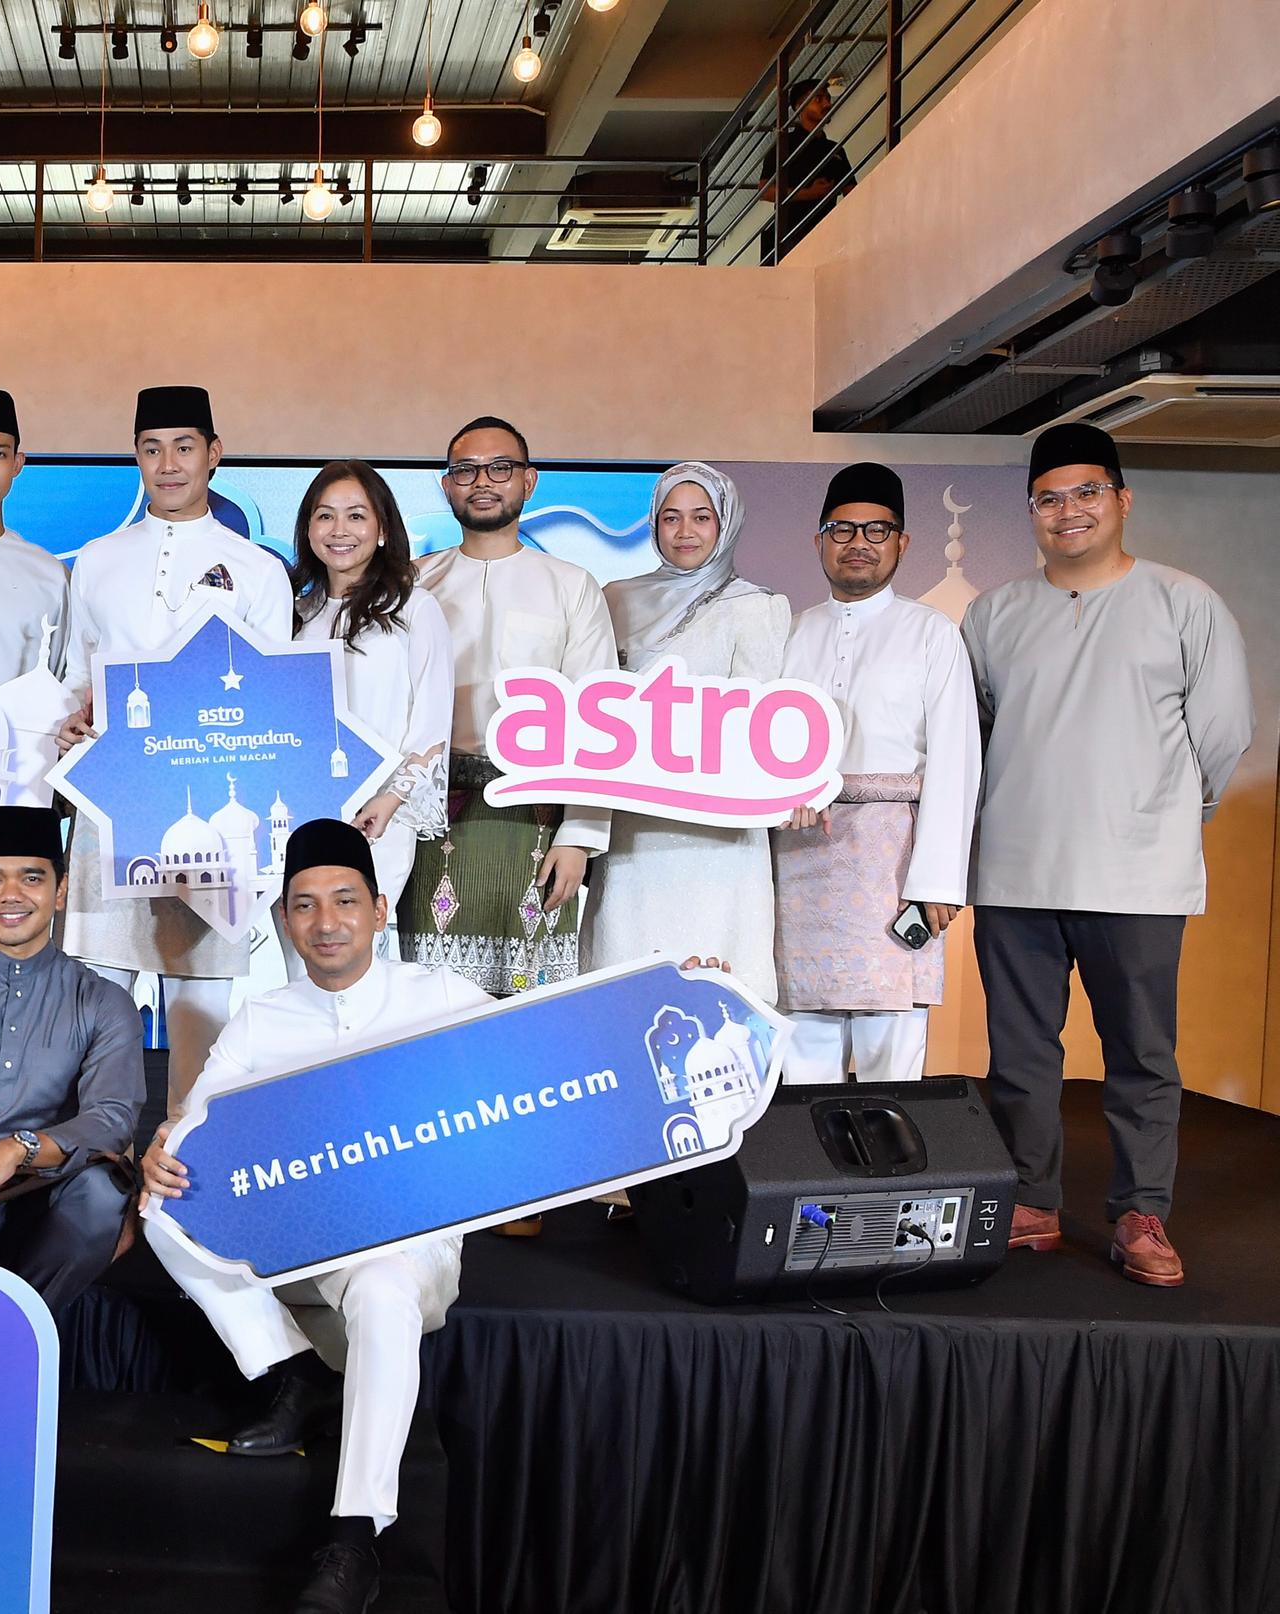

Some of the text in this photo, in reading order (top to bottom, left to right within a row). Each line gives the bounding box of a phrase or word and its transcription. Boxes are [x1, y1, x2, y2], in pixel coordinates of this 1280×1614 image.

[197, 706, 244, 723] astro
[496, 665, 830, 780] astro
[143, 729, 302, 755] Salam Ramadan
[170, 753, 276, 766] MERIAH LAIN MACAM
[229, 1066, 620, 1199] #MeriahLainMacam
